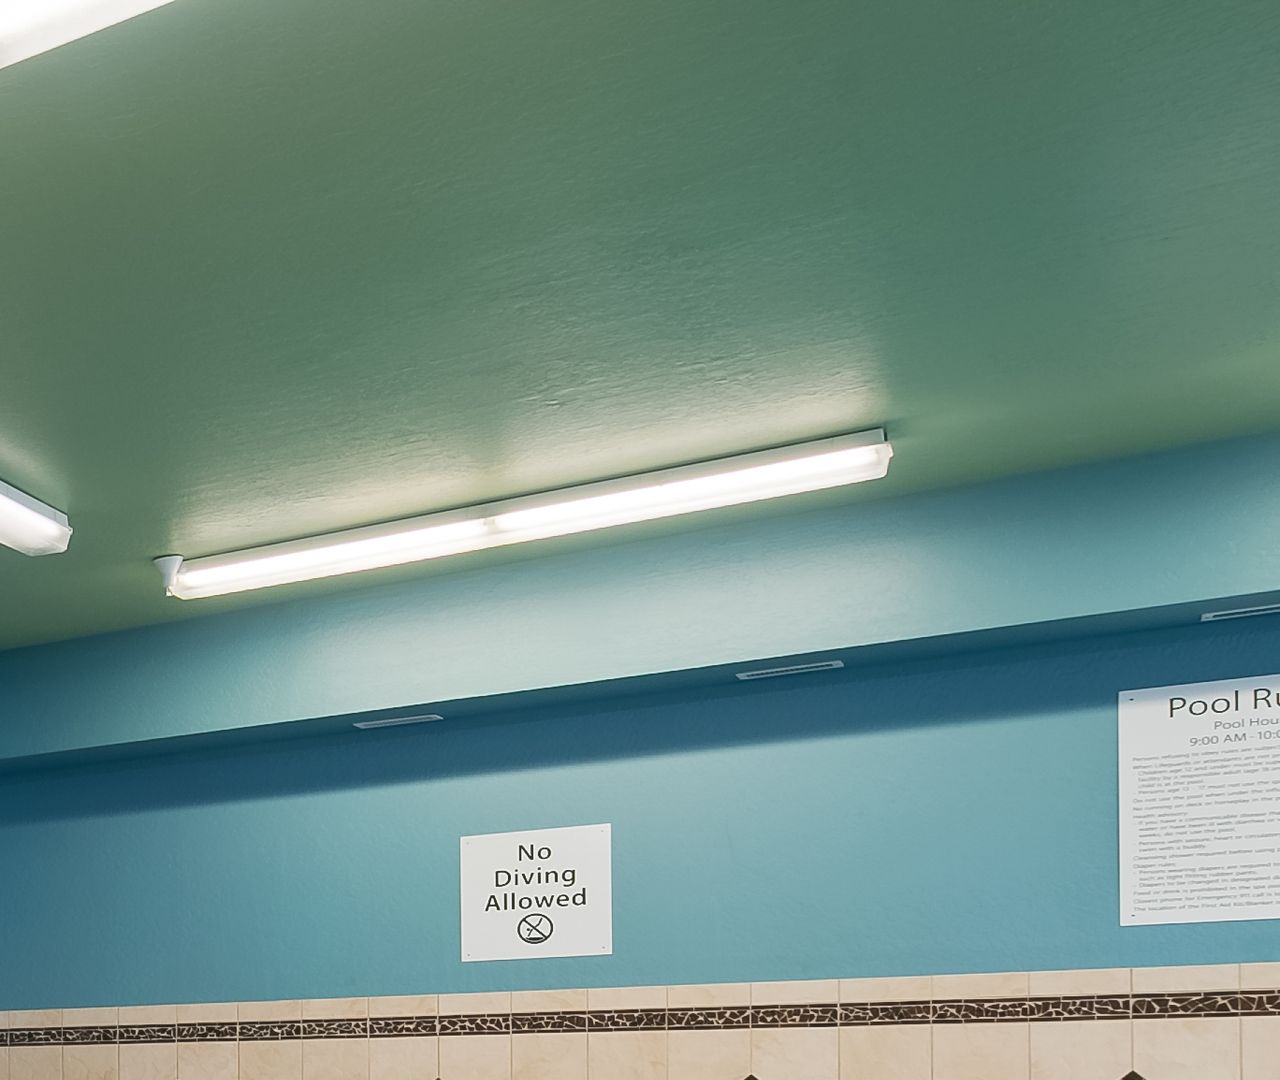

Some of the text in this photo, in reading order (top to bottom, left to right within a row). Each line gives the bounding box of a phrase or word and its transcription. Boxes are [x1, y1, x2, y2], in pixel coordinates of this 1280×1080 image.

[1169, 689, 1239, 718] Pool
[1214, 718, 1245, 730] Pool
[1189, 735, 1220, 747] 9:00
[1223, 732, 1247, 743] AM
[518, 844, 552, 861] No
[495, 867, 576, 887] Diving
[485, 888, 587, 911] Allowed
